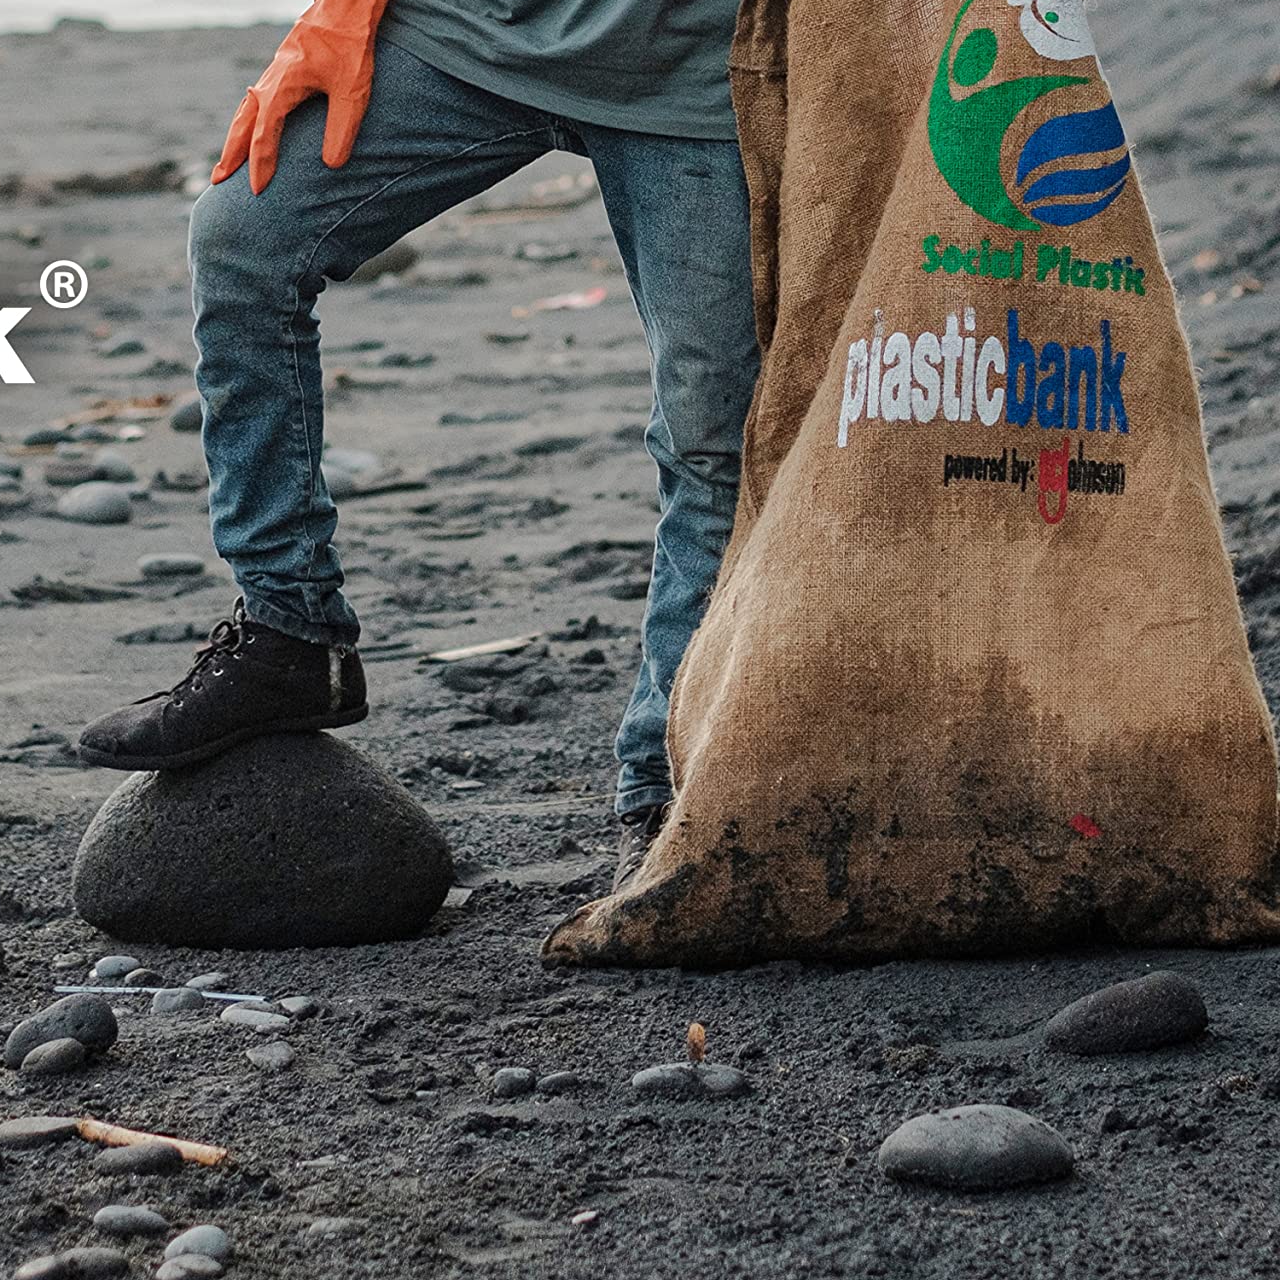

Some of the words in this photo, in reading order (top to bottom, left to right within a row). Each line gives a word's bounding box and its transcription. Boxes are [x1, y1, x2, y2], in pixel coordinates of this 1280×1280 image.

[921, 234, 1025, 281] Social
[837, 306, 1130, 448] plasticbank
[944, 447, 1008, 488] powered
